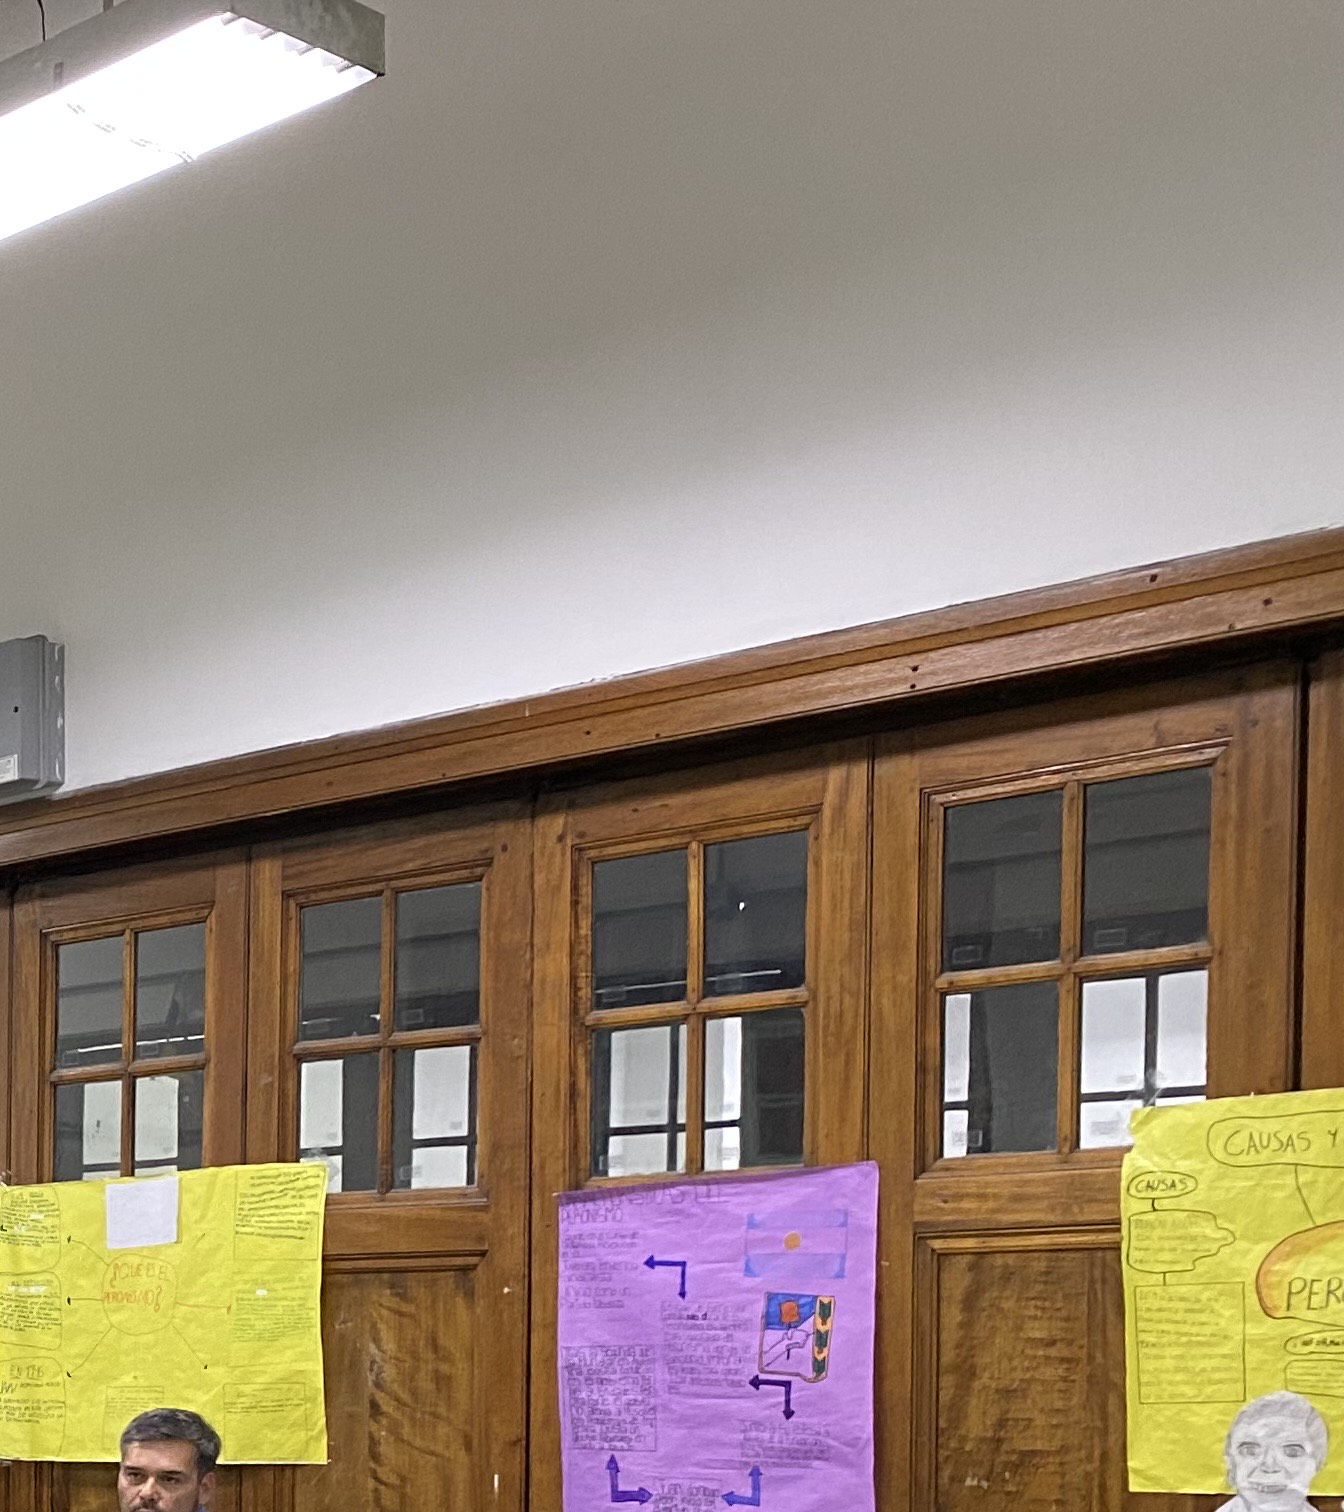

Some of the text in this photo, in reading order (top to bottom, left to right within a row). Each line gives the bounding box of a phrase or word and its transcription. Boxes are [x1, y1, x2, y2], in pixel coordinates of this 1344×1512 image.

[1224, 1128, 1338, 1156] CAUSAS Y
[1135, 1177, 1188, 1193] CAUSAS
[1286, 1277, 1344, 1312] PER
